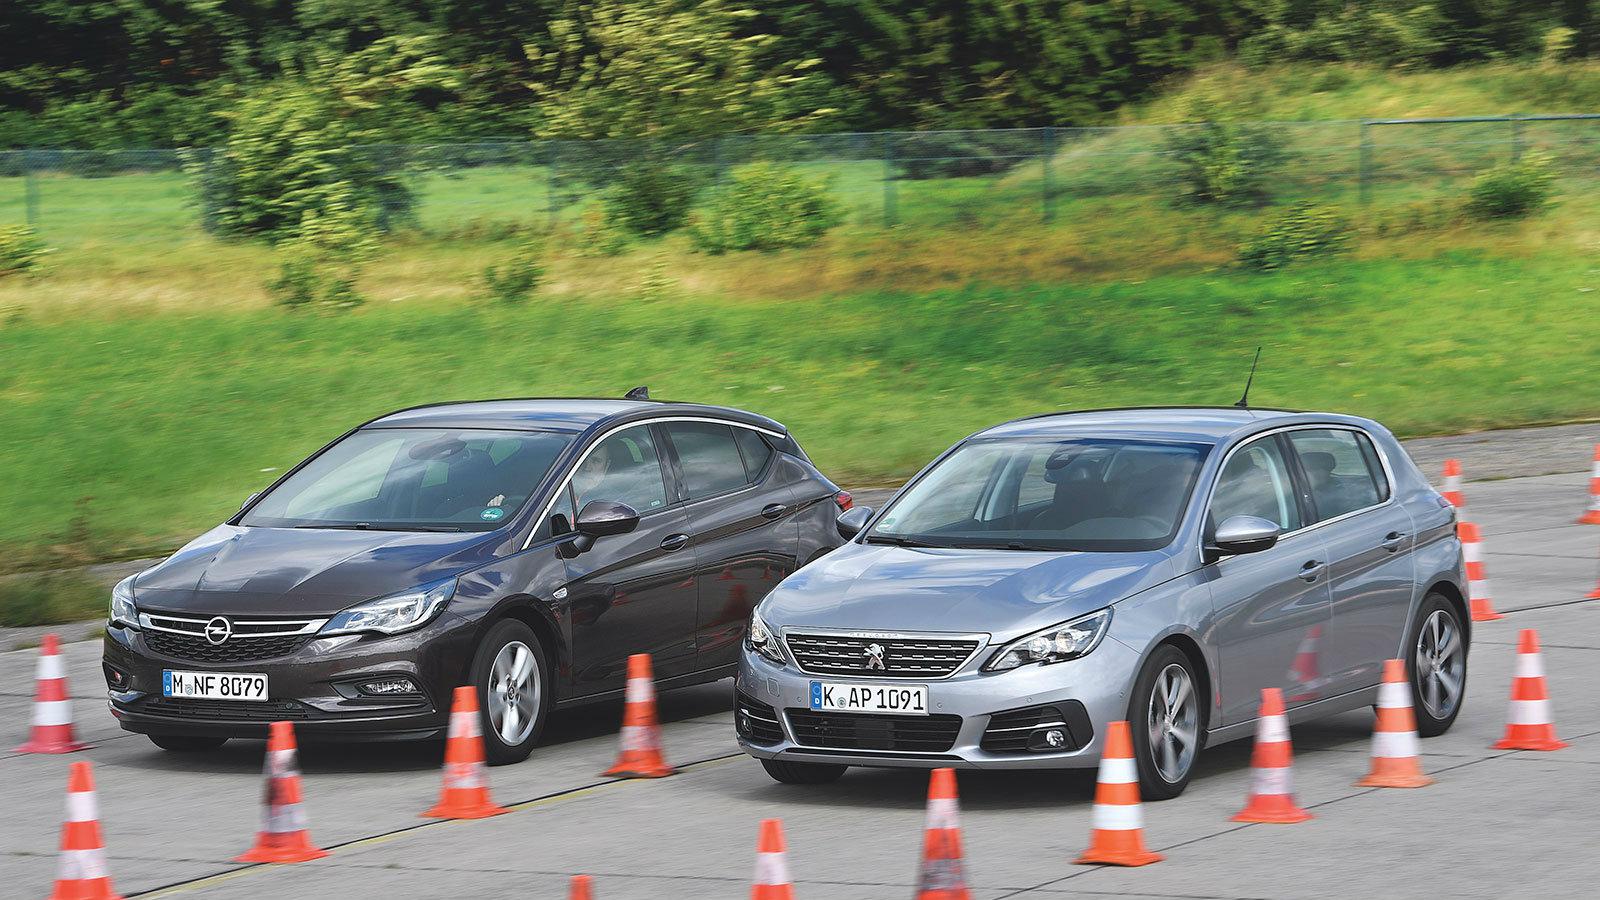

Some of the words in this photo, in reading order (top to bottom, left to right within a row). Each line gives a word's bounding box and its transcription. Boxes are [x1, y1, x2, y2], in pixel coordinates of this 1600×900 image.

[173, 674, 183, 694] M
[194, 675, 216, 695] NF
[220, 676, 265, 697] 8079
[823, 686, 835, 707] K
[848, 687, 872, 708] AP
[876, 689, 924, 710] 1091
